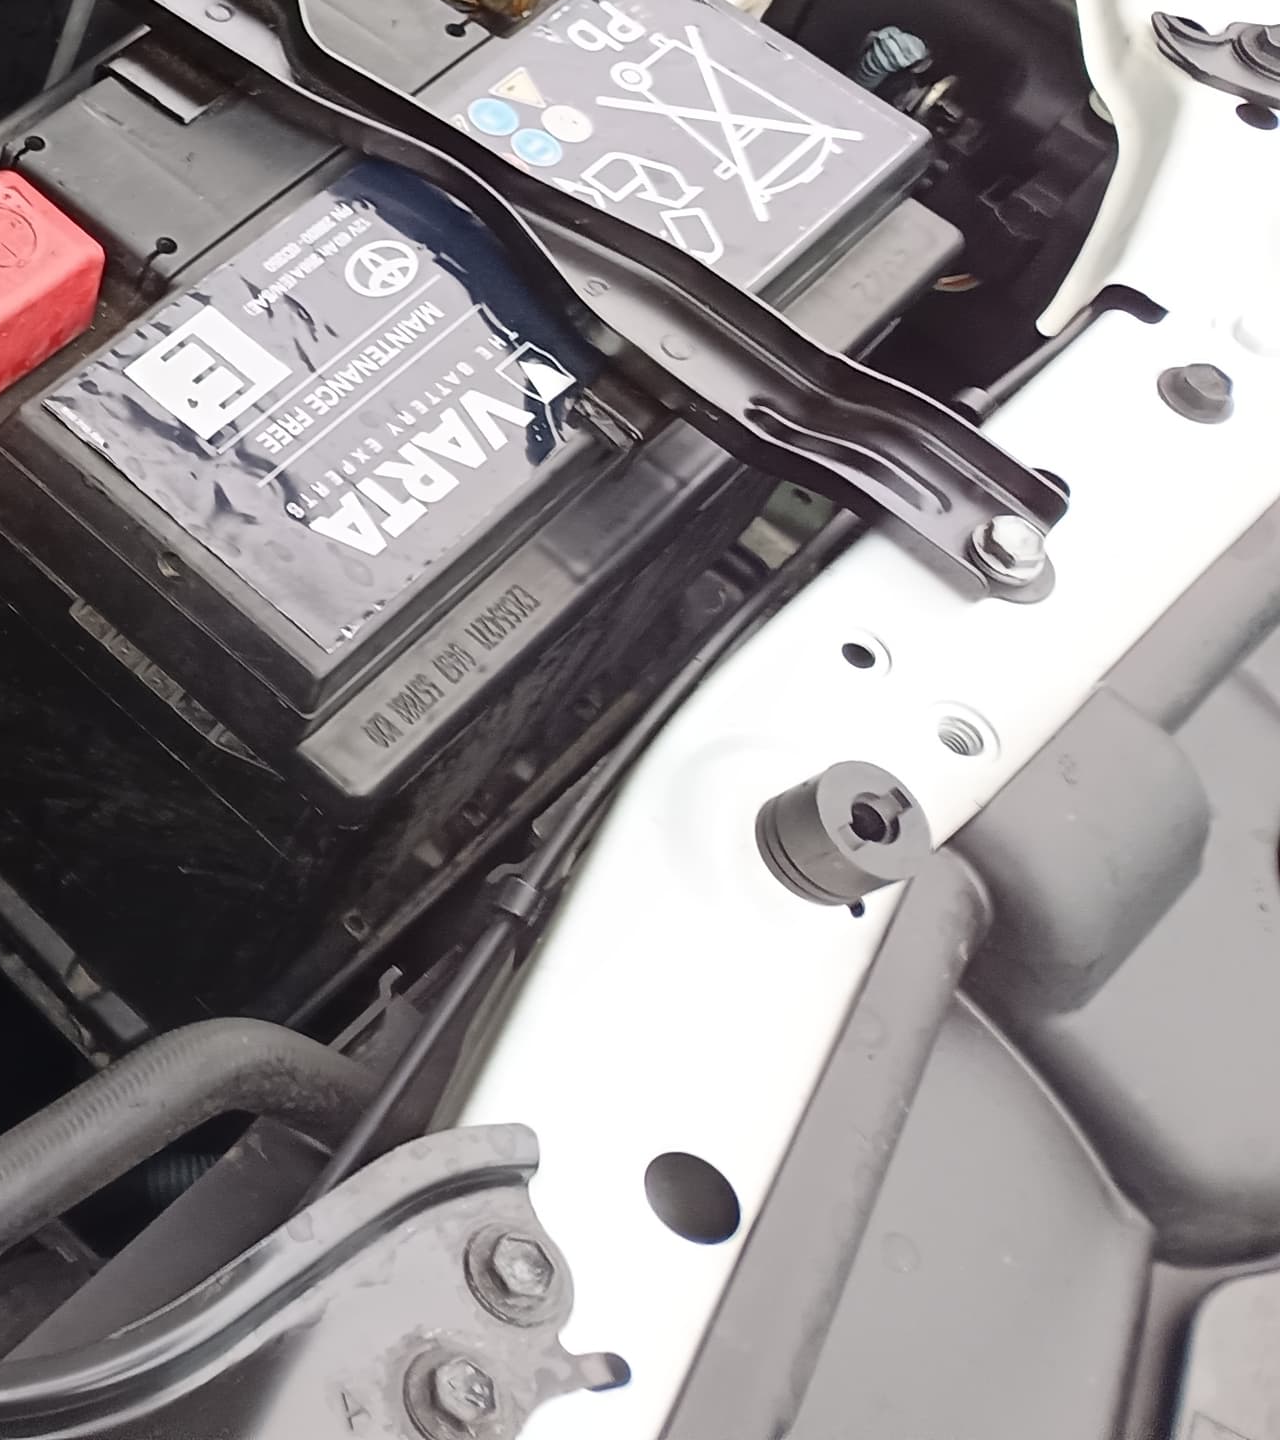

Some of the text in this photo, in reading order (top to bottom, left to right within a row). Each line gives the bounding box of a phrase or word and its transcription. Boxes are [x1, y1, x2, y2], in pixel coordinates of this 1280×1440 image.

[567, 0, 646, 52] Pb
[255, 300, 446, 454] MAINTENANCE FREE
[474, 325, 519, 360] THE
[385, 361, 475, 436] BATTERY
[308, 390, 537, 557] VARTA
